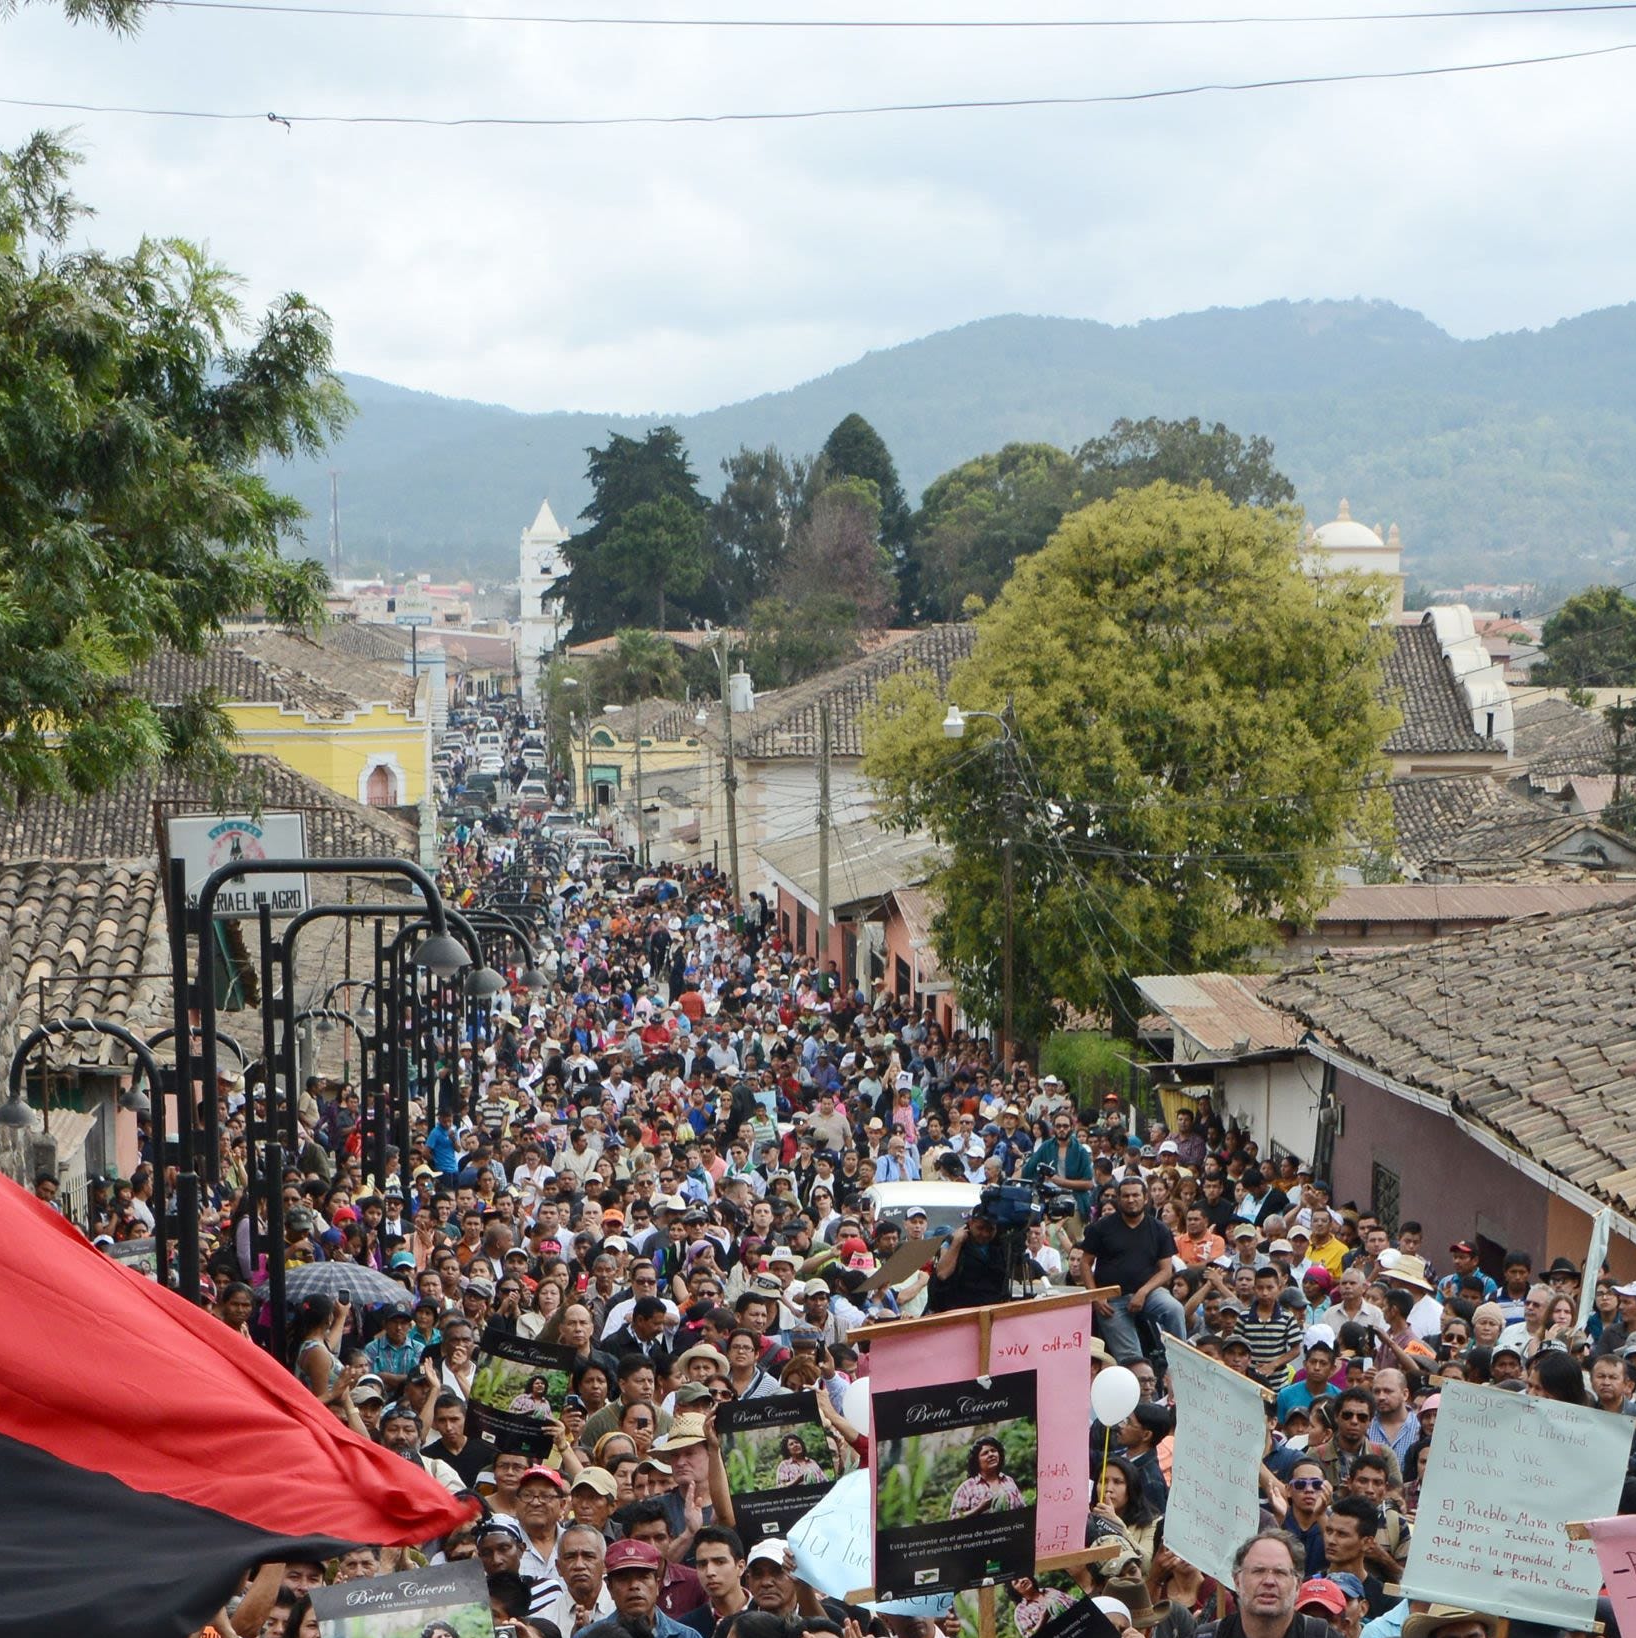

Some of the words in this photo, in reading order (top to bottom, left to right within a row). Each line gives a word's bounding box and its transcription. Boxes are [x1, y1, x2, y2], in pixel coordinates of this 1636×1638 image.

[236, 893, 250, 911] EL
[733, 1410, 762, 1423] Berta
[905, 1404, 951, 1423] Berta
[957, 1396, 1009, 1416] Cáceres
[1443, 1499, 1454, 1512] El
[1464, 1500, 1508, 1522] Pueblo
[1438, 1516, 1491, 1534] Exigimos
[1432, 1536, 1461, 1550] quede
[1469, 1543, 1482, 1553] en
[1489, 1546, 1499, 1557] la
[1426, 1553, 1481, 1572] asesinato
[1493, 1564, 1503, 1577] de
[346, 1588, 394, 1606] Berta
[398, 1581, 456, 1598] Cáceres
